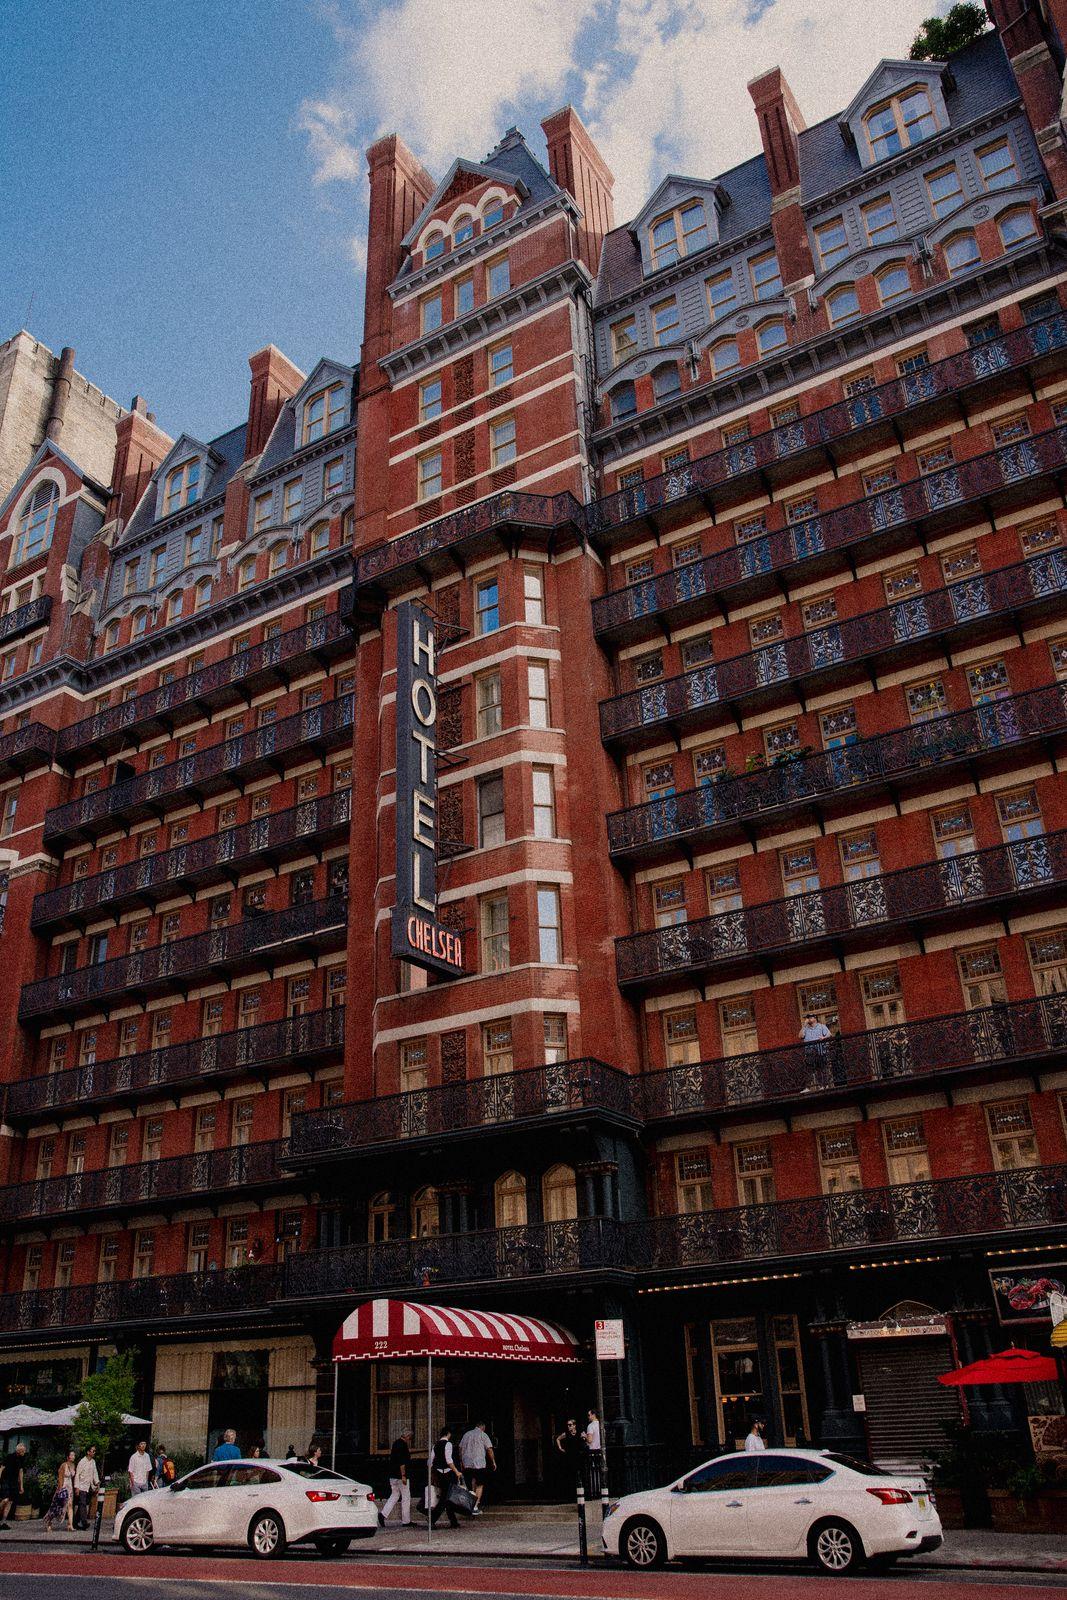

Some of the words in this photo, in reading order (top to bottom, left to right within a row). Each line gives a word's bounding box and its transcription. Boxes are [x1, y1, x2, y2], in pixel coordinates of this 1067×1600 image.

[412, 619, 436, 913] HOTEL
[408, 916, 462, 967] CHELSEA
[597, 1321, 603, 1330] 3
[374, 1340, 388, 1350] 222
